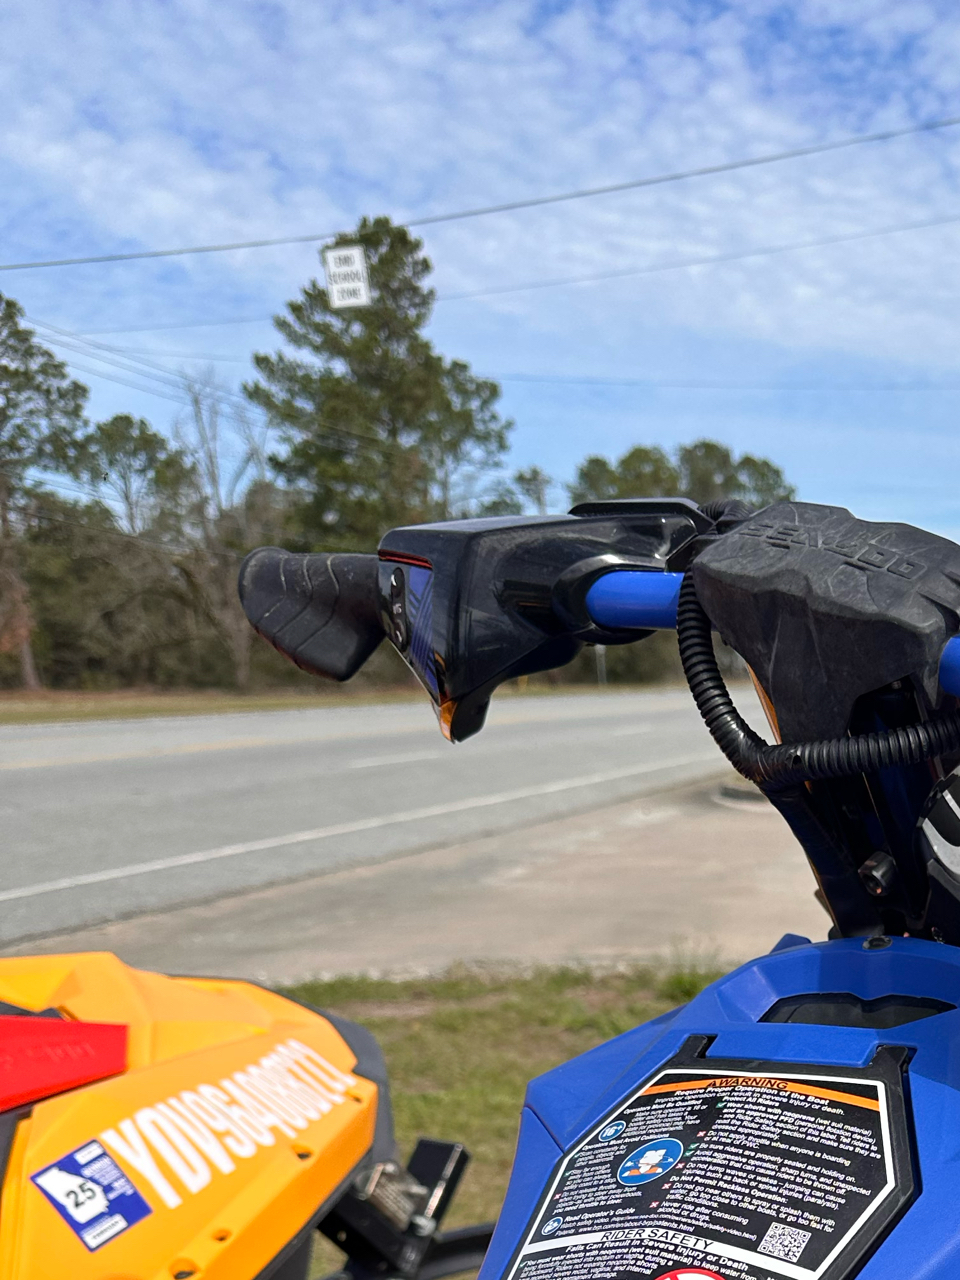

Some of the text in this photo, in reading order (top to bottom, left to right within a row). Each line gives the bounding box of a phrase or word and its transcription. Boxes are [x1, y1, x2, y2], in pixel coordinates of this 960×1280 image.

[674, 1088, 705, 1096] Require
[734, 1084, 779, 1095] Operation
[790, 1091, 805, 1100] the
[807, 1094, 829, 1105] Boat
[716, 1077, 788, 1089] WARNING
[759, 1098, 779, 1106] Riders
[760, 1093, 787, 1102] severe
[788, 1097, 810, 1108] injury
[821, 1104, 845, 1115] death.
[728, 1132, 747, 1141] apply
[747, 1134, 770, 1145] throttle
[770, 1140, 789, 1150] when
[789, 1145, 814, 1156] anyone
[821, 1151, 850, 1167] boarding
[708, 1143, 723, 1151] sure
[723, 1145, 743, 1154] riders
[755, 1152, 783, 1164] properly
[783, 1159, 807, 1169] seated
[806, 1164, 820, 1173] and
[820, 1166, 844, 1180] holding
[845, 1175, 855, 1183] on.
[66, 1182, 97, 1210] 25
[692, 1176, 716, 1184] Permit
[716, 1180, 749, 1193] Reckless
[750, 1187, 788, 1204] Operation:
[657, 1206, 680, 1214] alcohol
[689, 1210, 710, 1221] drugs.
[660, 1200, 748, 1225] Never ride after consuming
[600, 1227, 714, 1251] RIDER SAFETY
[565, 1243, 584, 1252] Falls
[603, 1239, 631, 1248] Result
[641, 1238, 674, 1250] Severe
[675, 1244, 704, 1261] Injury
[706, 1253, 717, 1262] or
[719, 1256, 748, 1271] Death
